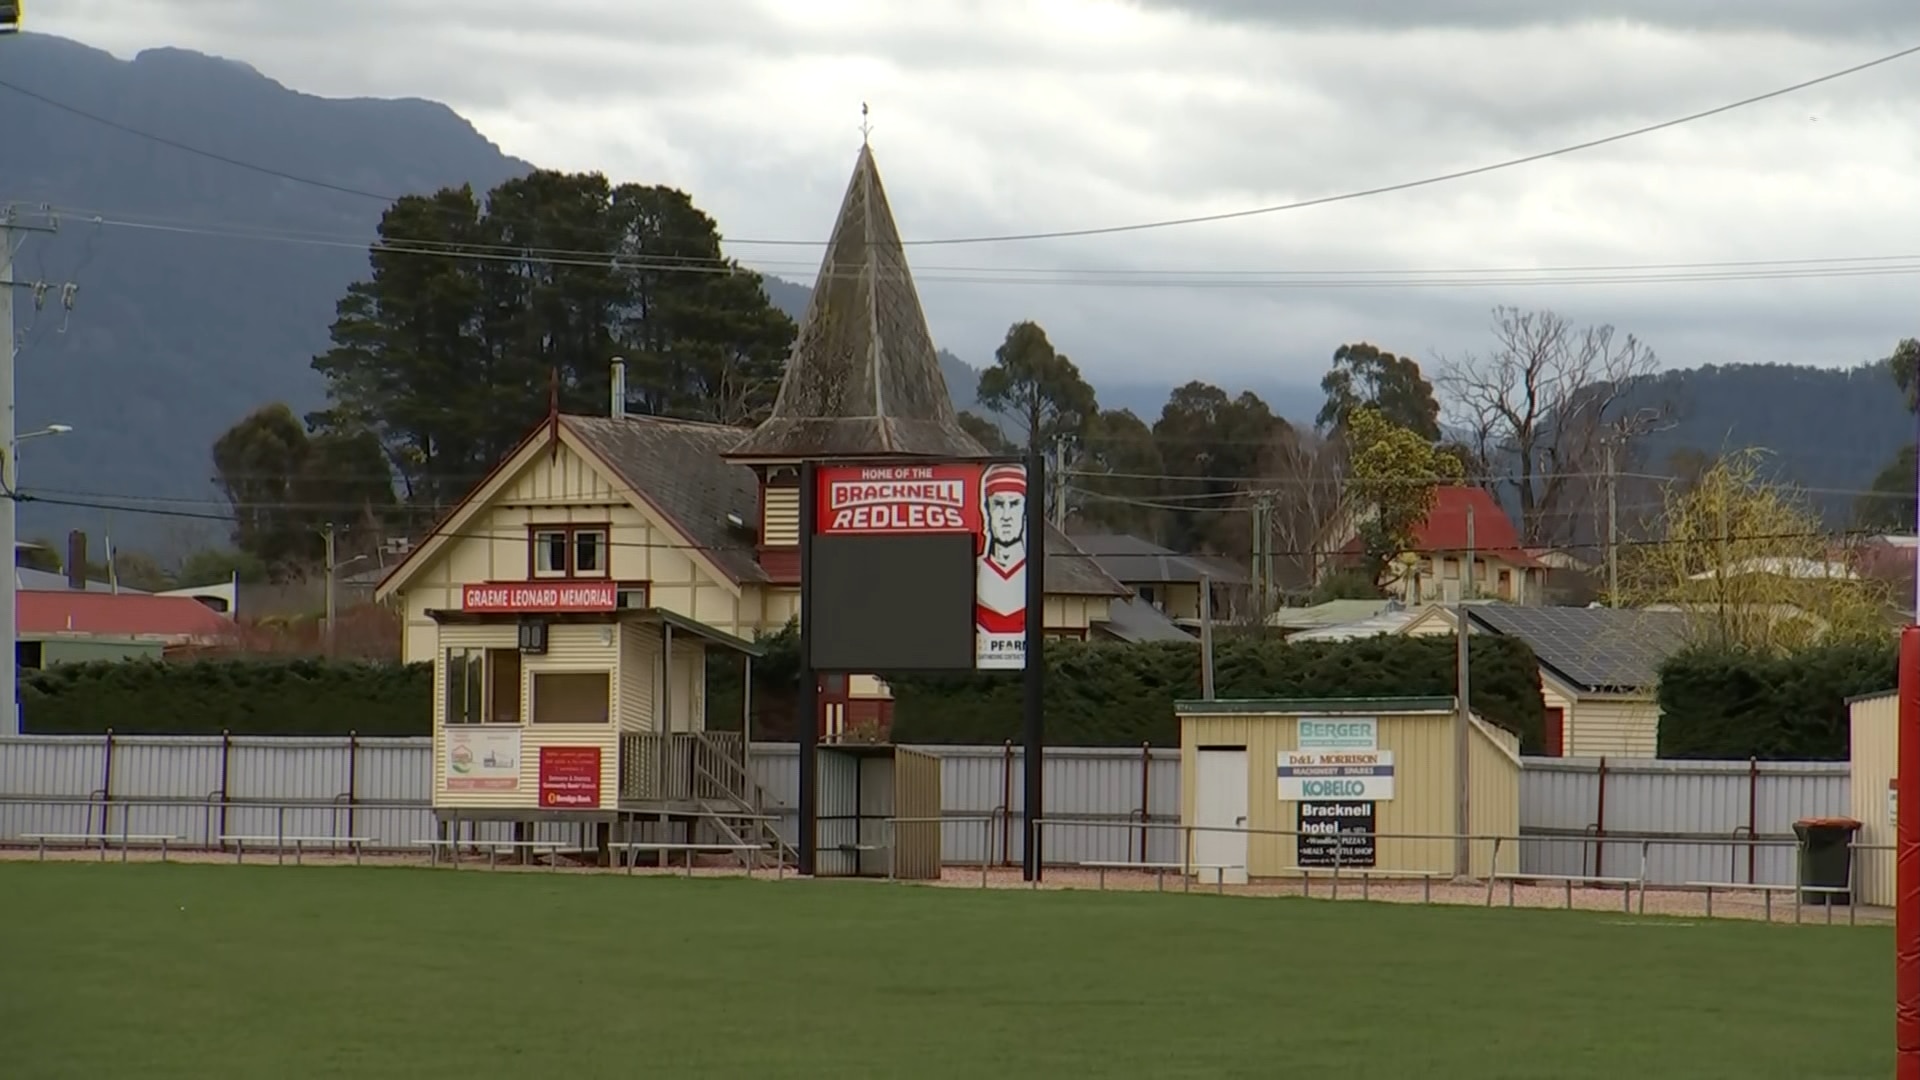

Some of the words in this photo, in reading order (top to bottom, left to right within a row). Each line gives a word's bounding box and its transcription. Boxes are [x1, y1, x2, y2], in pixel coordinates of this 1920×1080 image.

[862, 468, 894, 479] HOME
[895, 468, 911, 479] OF
[912, 467, 933, 478] THE
[834, 483, 961, 503] BRACKNELL
[832, 504, 964, 529] REDLEGS
[467, 589, 508, 607] GRAEME
[510, 589, 558, 607] LEONARD
[560, 588, 613, 606] MEMORIAL
[1300, 721, 1372, 738] BERGER
[1320, 754, 1378, 764] MORRISON
[1302, 780, 1365, 797] KOBELCO
[1302, 803, 1371, 817] Bracknell
[1302, 821, 1338, 834] hotel
